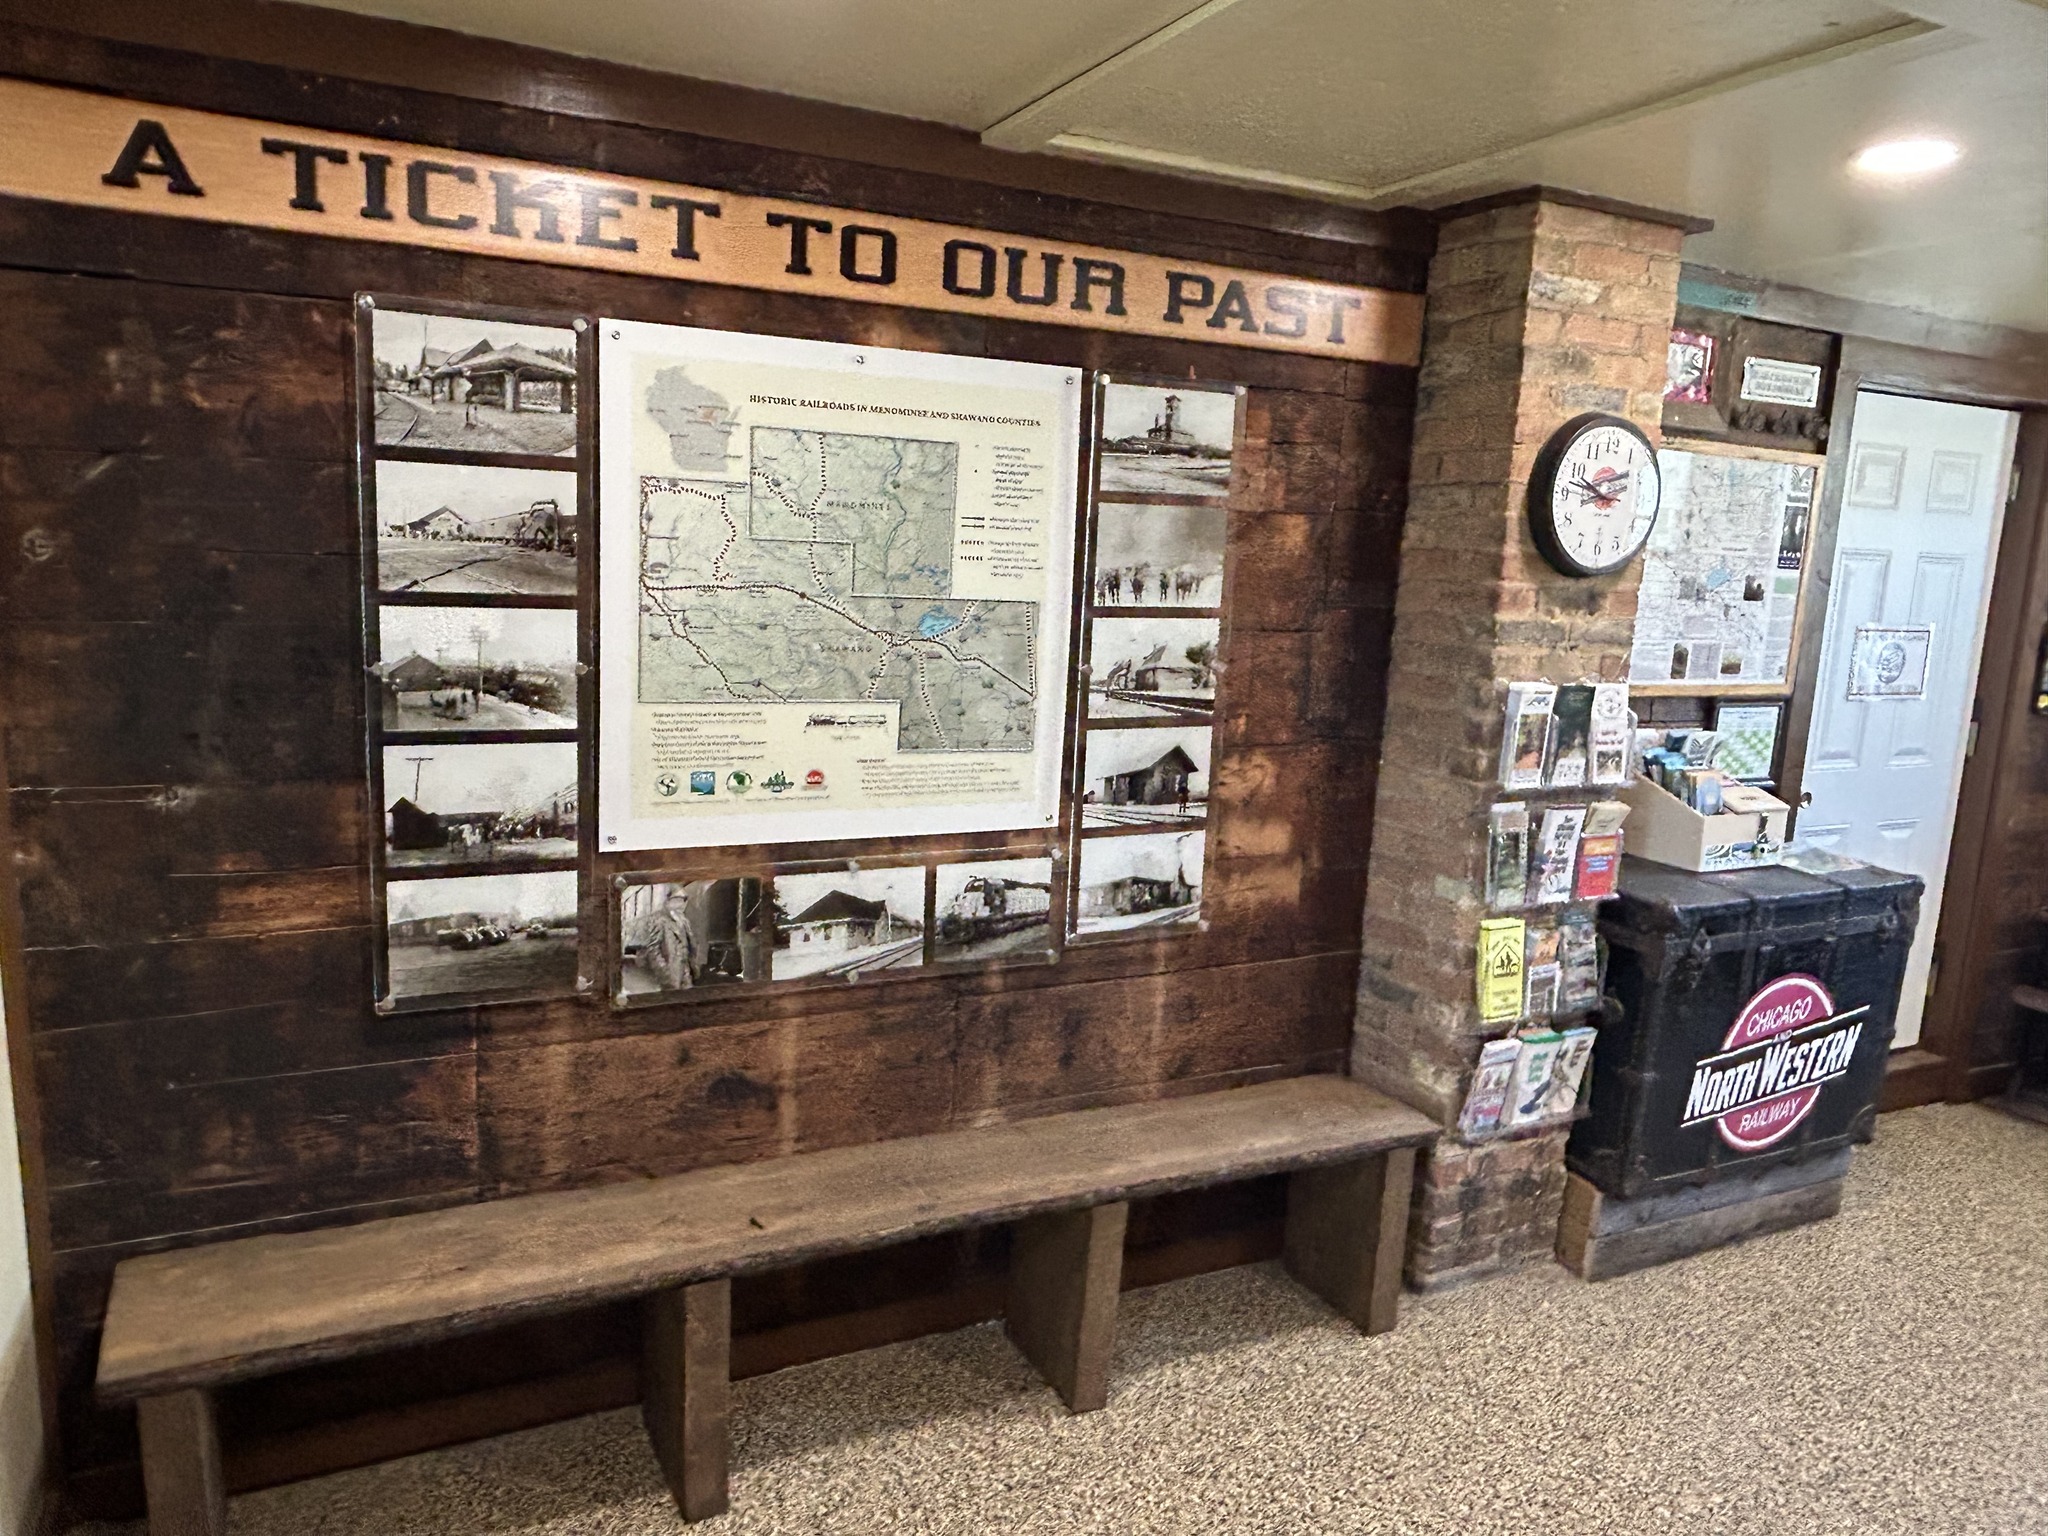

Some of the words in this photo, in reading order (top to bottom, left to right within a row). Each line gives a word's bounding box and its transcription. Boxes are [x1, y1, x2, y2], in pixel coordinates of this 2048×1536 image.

[101, 119, 206, 197] A
[261, 138, 721, 261] TICKET
[766, 213, 897, 285] TO
[942, 239, 1127, 316] OUR
[1163, 270, 1362, 345] PAST
[749, 394, 797, 407] HISTORIC
[799, 399, 856, 412] RAILROADS
[857, 404, 868, 413] IN
[996, 416, 1041, 427] COUNTIES
[1746, 995, 1812, 1037] CHICAGO
[1683, 1057, 1762, 1121] NORTH
[1757, 1022, 1864, 1097] WESTERN
[1738, 1096, 1802, 1133] RAILWAY
